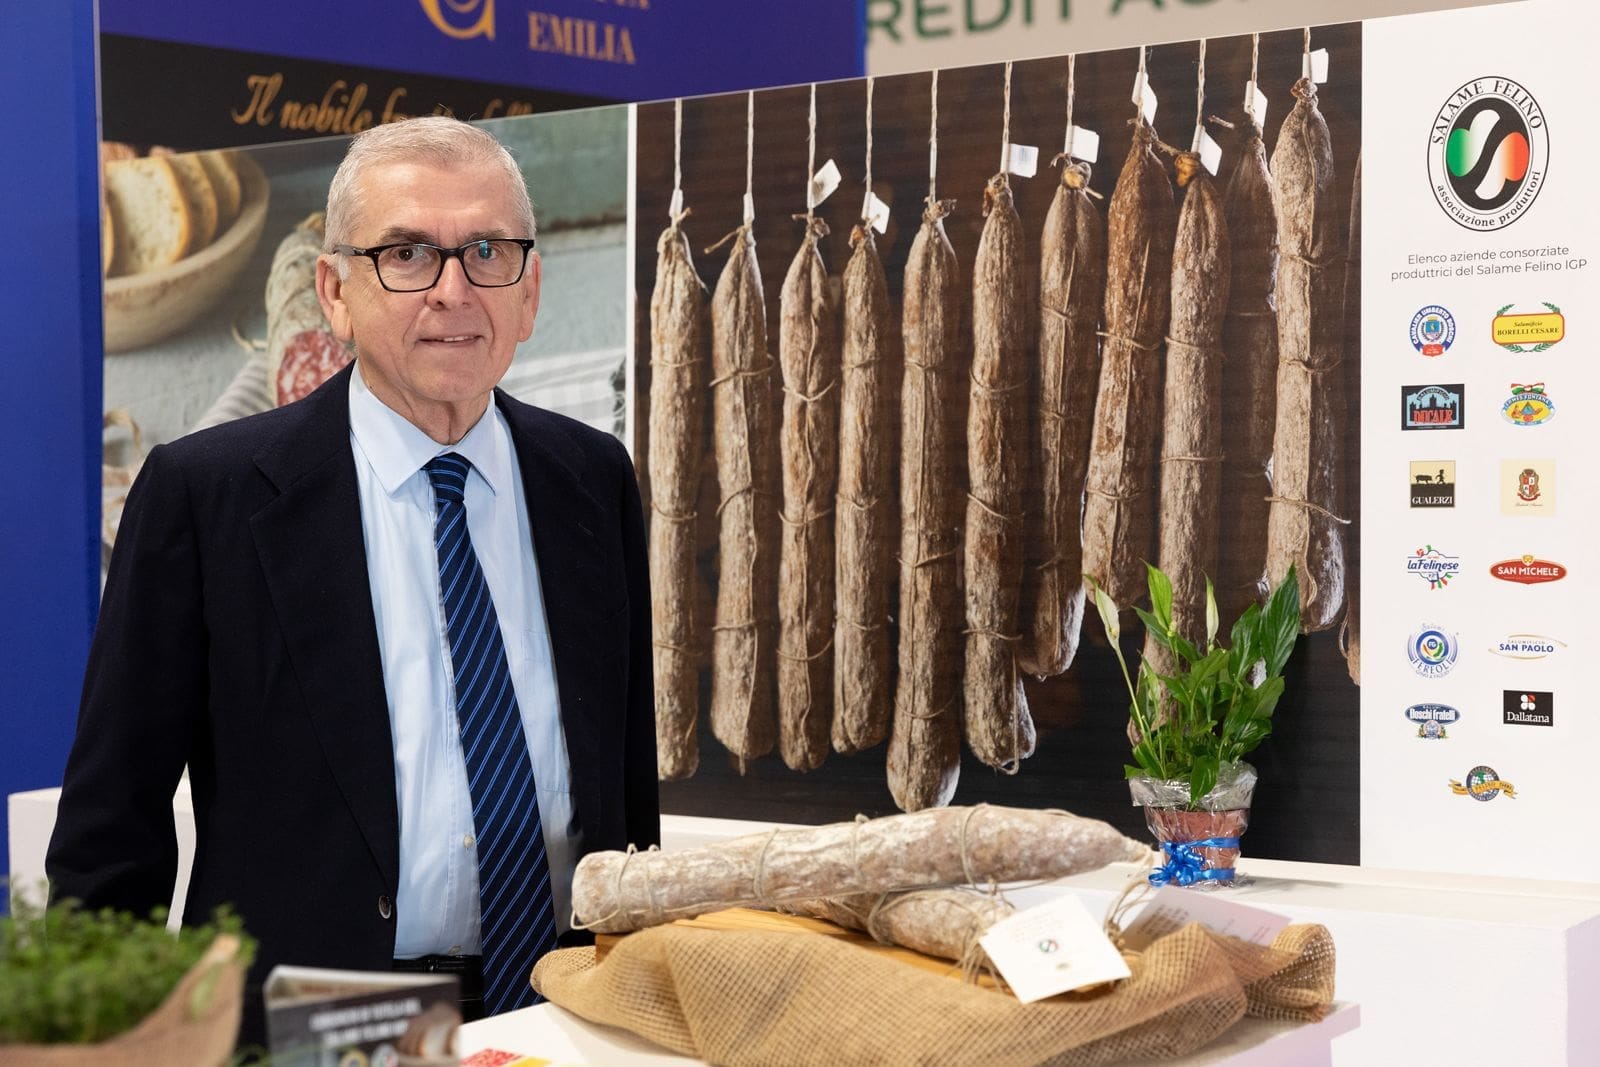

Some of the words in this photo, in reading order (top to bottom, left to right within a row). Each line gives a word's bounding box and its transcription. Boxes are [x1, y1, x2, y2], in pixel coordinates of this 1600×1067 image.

[528, 11, 636, 65] EMILIA
[231, 72, 284, 126] Il
[280, 79, 374, 134] nobile
[1432, 80, 1484, 145] SALAME
[1493, 79, 1543, 130] FELINO
[1436, 183, 1496, 227] associazione
[1498, 170, 1542, 225] produttori
[1407, 253, 1448, 265] Elenco
[1450, 249, 1497, 263] aziende
[1499, 245, 1570, 260] consorziate
[1391, 267, 1453, 282] produttrici
[1455, 265, 1474, 277] del
[1476, 262, 1522, 275] Salame
[1524, 259, 1563, 272] Felino
[1565, 258, 1588, 271] IGP
[1497, 328, 1529, 336] BORELLI
[1530, 327, 1560, 335] CESARE
[1411, 496, 1453, 505] GUALERZI
[1497, 566, 1517, 575] SAN
[1518, 567, 1559, 576] MICHELE
[1499, 643, 1518, 651] SAN
[1521, 644, 1554, 653] PAOLO
[1506, 711, 1550, 723] Dallatana
